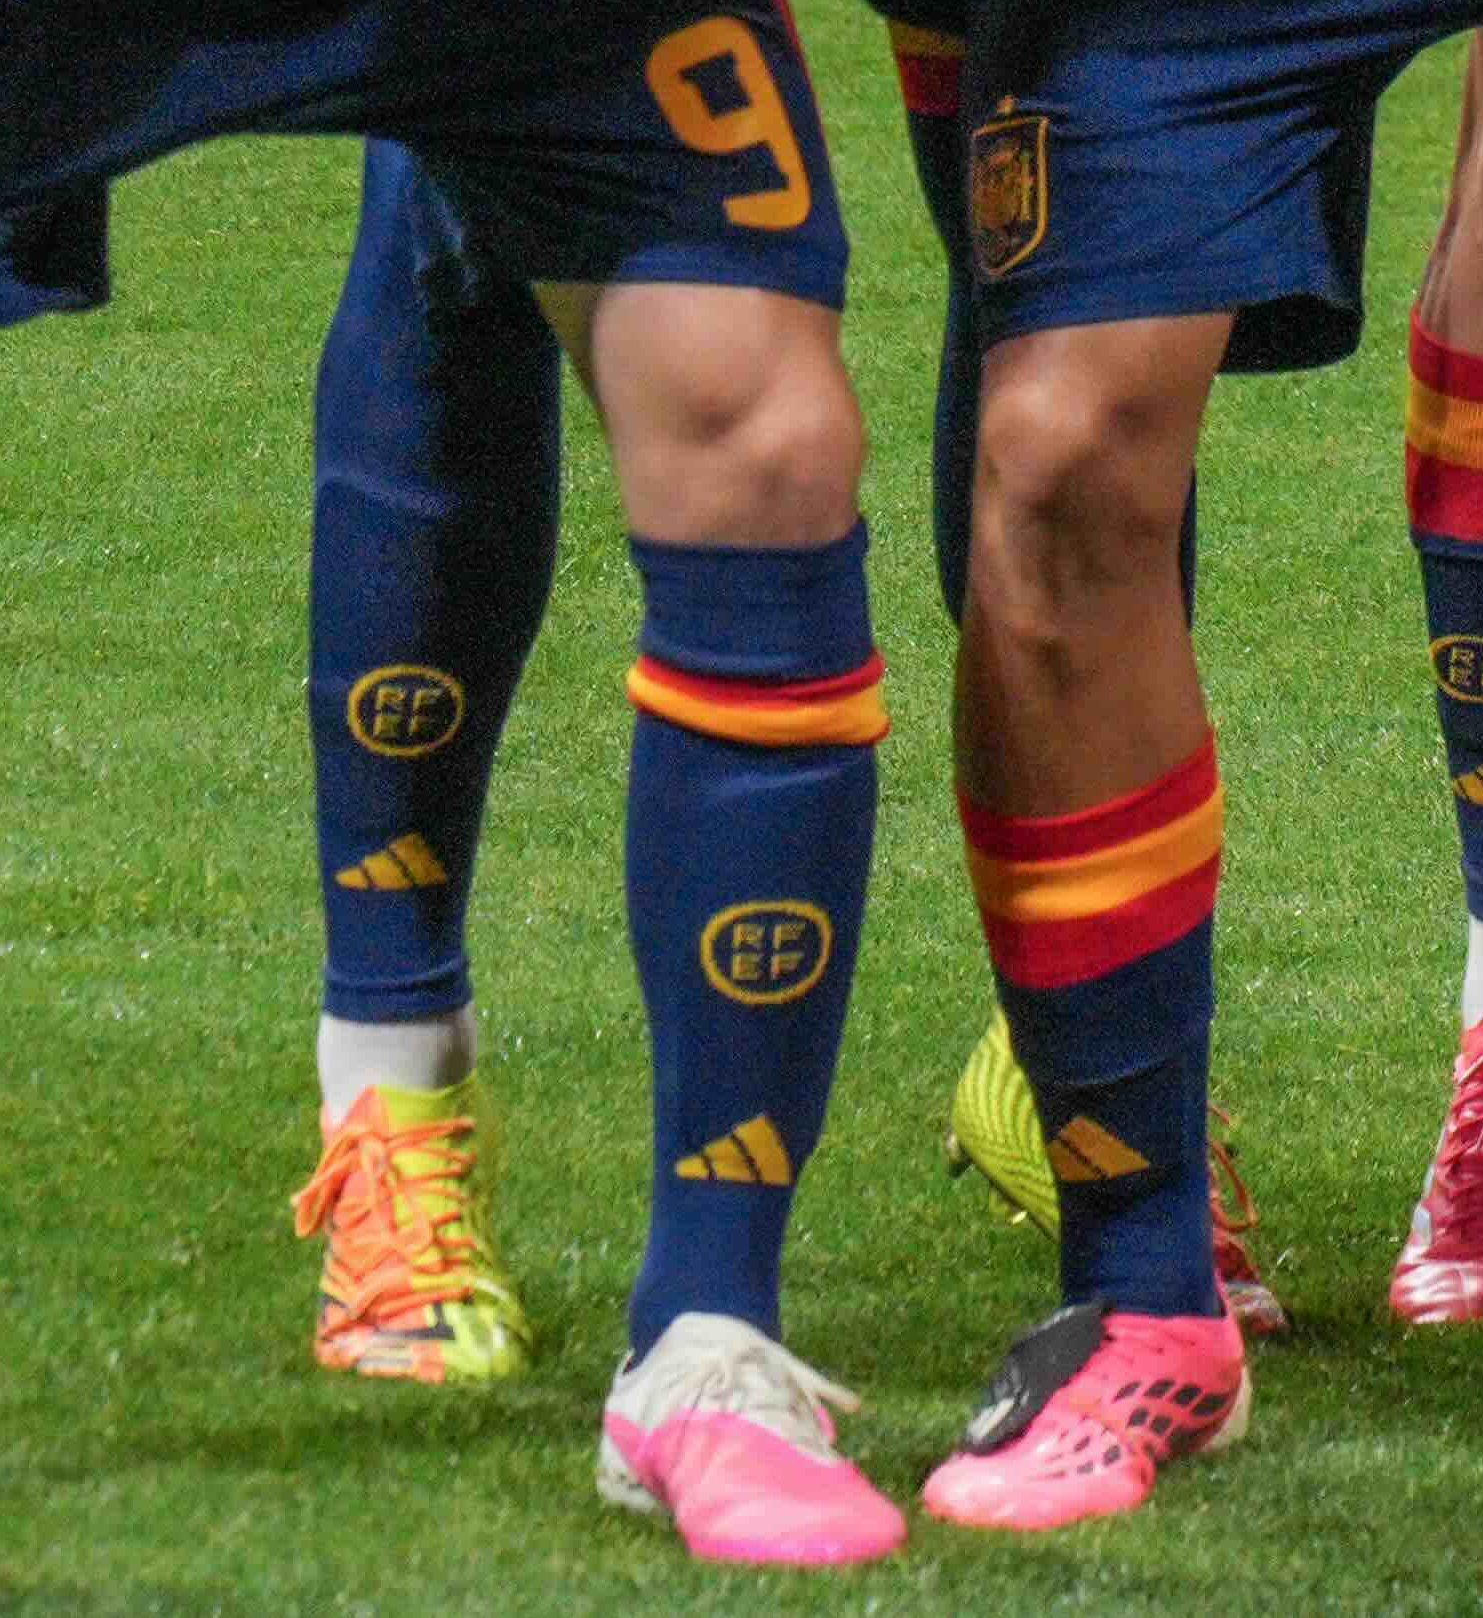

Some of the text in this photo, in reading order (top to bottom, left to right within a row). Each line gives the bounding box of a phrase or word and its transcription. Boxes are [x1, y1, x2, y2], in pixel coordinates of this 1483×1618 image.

[645, 15, 813, 231] 9
[374, 683, 442, 711] RF
[372, 712, 436, 739] EF
[732, 922, 806, 950] RF
[731, 951, 803, 981] EF
